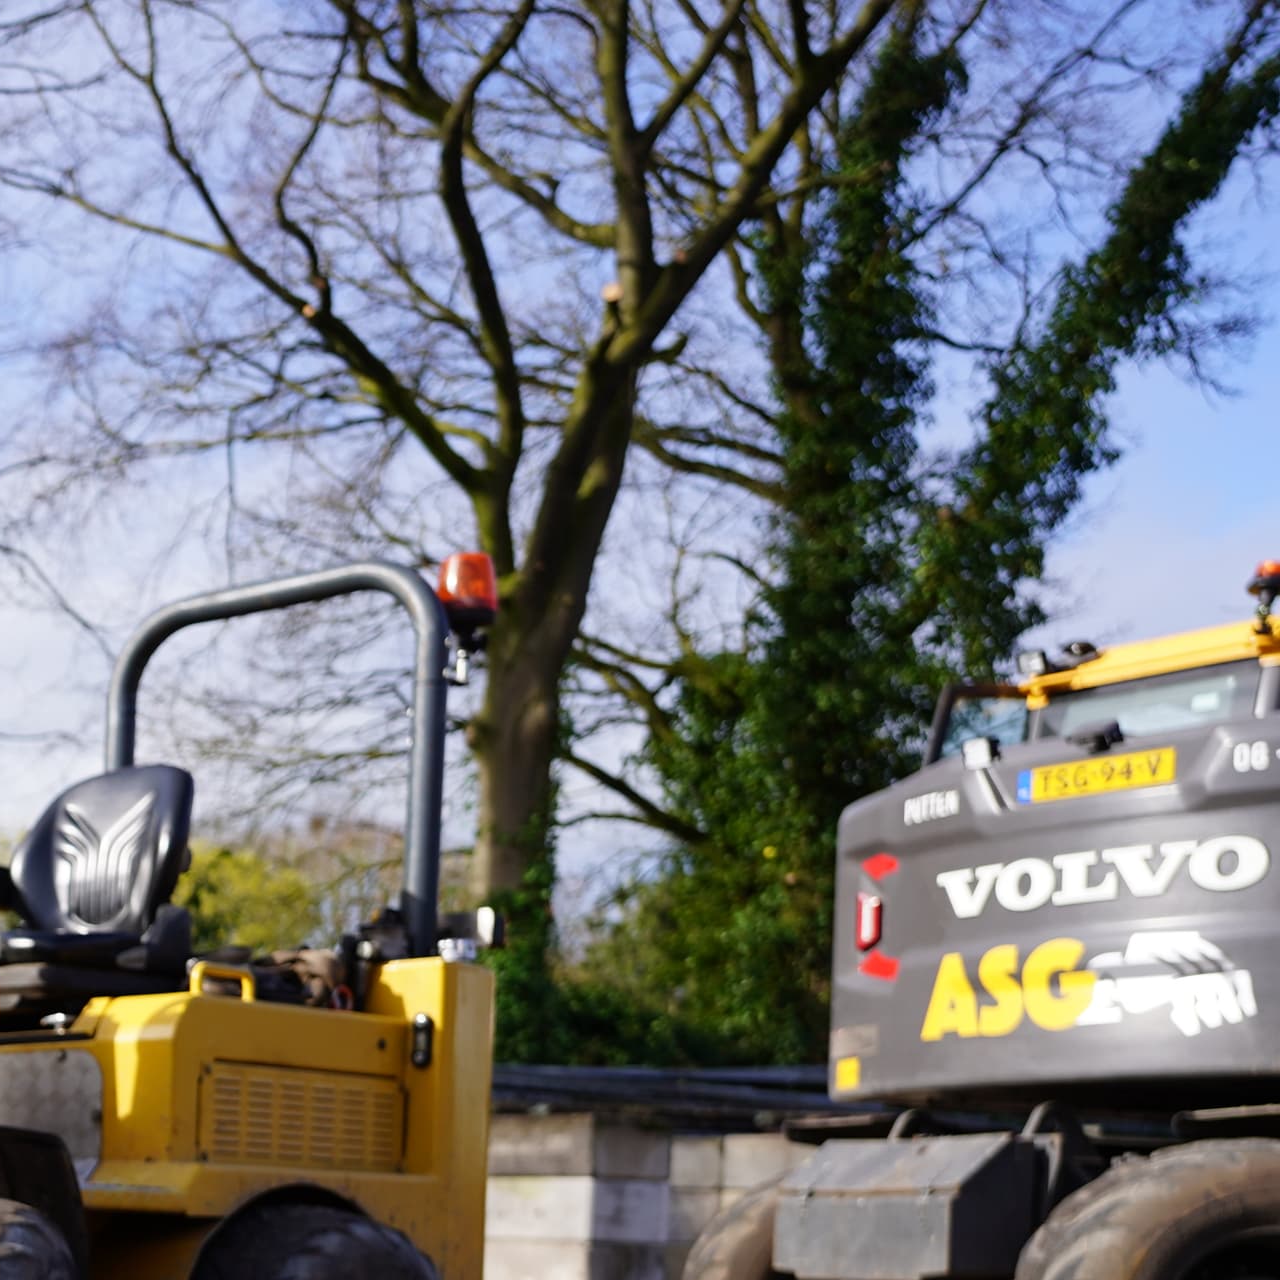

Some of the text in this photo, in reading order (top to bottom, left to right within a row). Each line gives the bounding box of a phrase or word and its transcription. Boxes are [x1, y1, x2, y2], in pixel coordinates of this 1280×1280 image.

[1041, 754, 1162, 792] TSG-94-V
[937, 835, 1270, 919] VOLVO
[920, 938, 1099, 1042] ASG
